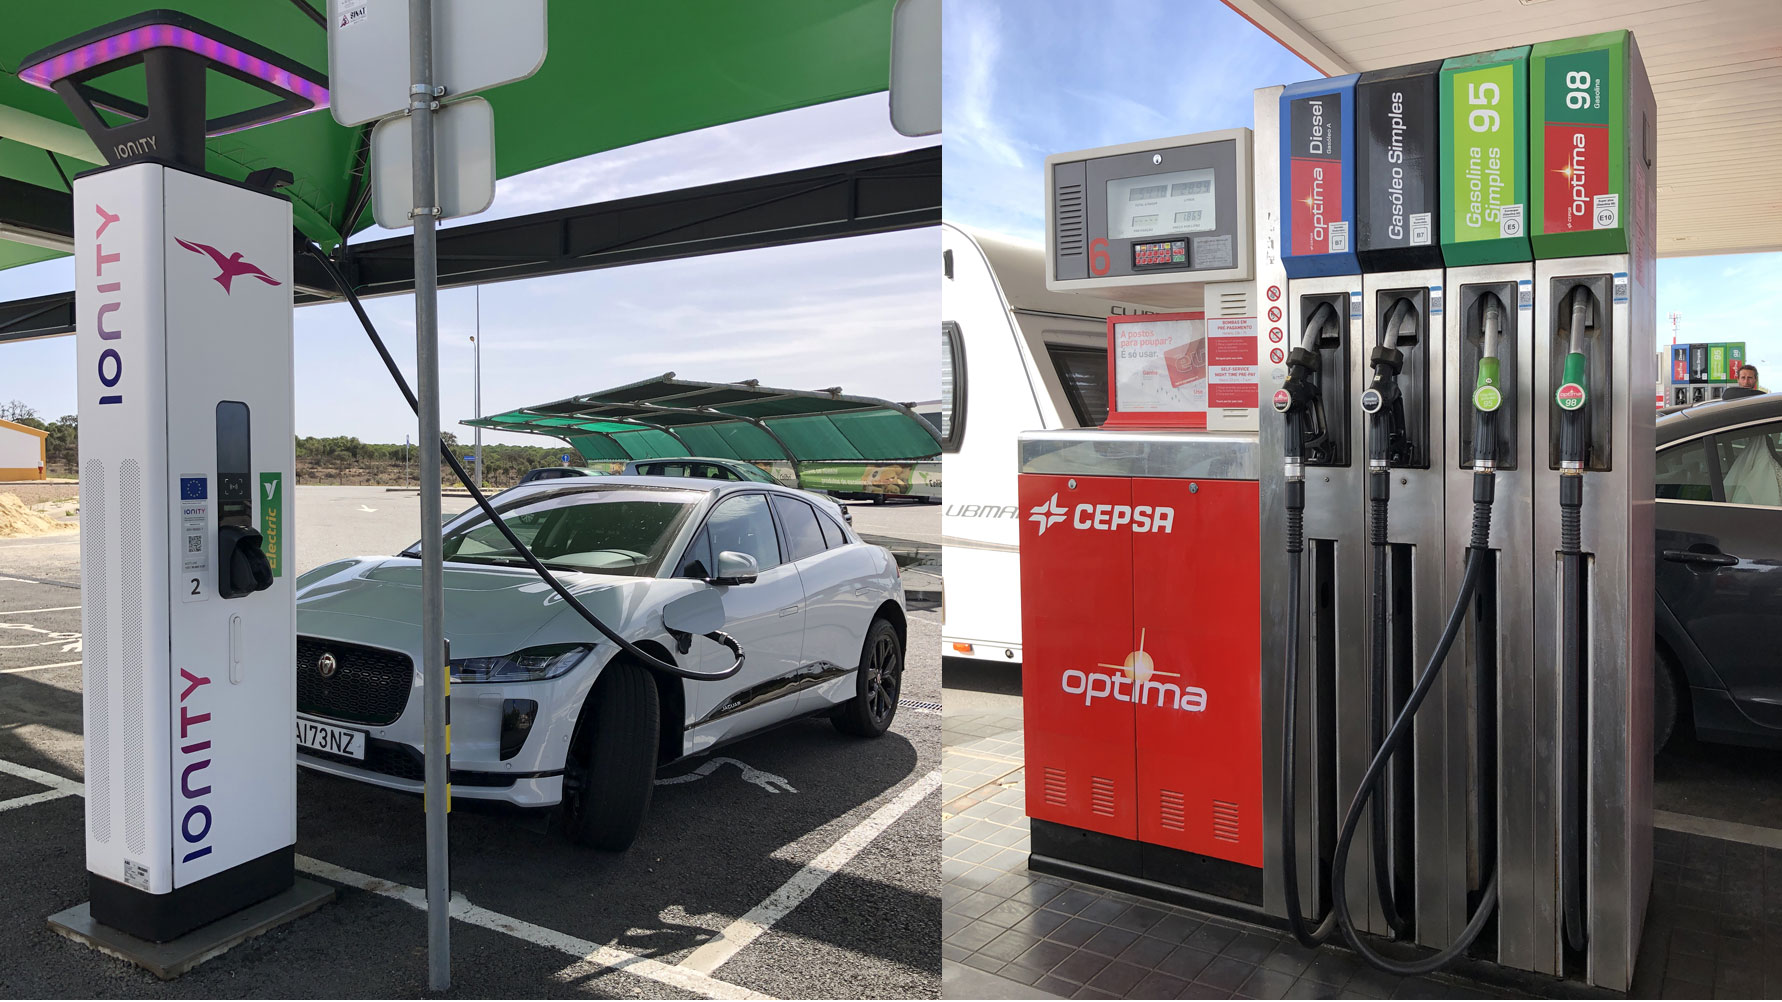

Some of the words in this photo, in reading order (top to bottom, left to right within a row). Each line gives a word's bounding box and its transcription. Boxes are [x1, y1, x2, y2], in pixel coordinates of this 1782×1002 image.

[1469, 82, 1500, 133] 95
[1566, 71, 1591, 109] 98
[114, 136, 156, 159] IONITY
[1309, 101, 1323, 154] Diesel
[1388, 92, 1406, 164] Simples
[1466, 147, 1482, 228] Gasolina
[1485, 147, 1504, 223] Simples
[1571, 133, 1590, 216] optima
[1312, 168, 1327, 241] optima
[1388, 167, 1403, 240] Gasóleo
[1089, 237, 1111, 276] 6
[96, 203, 123, 405] IONITY
[1120, 330, 1126, 339] A
[1128, 330, 1154, 339] postos
[1120, 340, 1138, 348] para
[1140, 336, 1173, 348] poupar?
[1121, 350, 1127, 359] É
[1128, 351, 1138, 359] só
[1565, 399, 1577, 407] 98
[945, 504, 1018, 519] UBMA
[1073, 503, 1175, 534] CEPSA
[265, 507, 277, 569] Electric
[190, 578, 201, 595] 2
[1061, 668, 1208, 713] optima
[180, 667, 212, 864] IONITY
